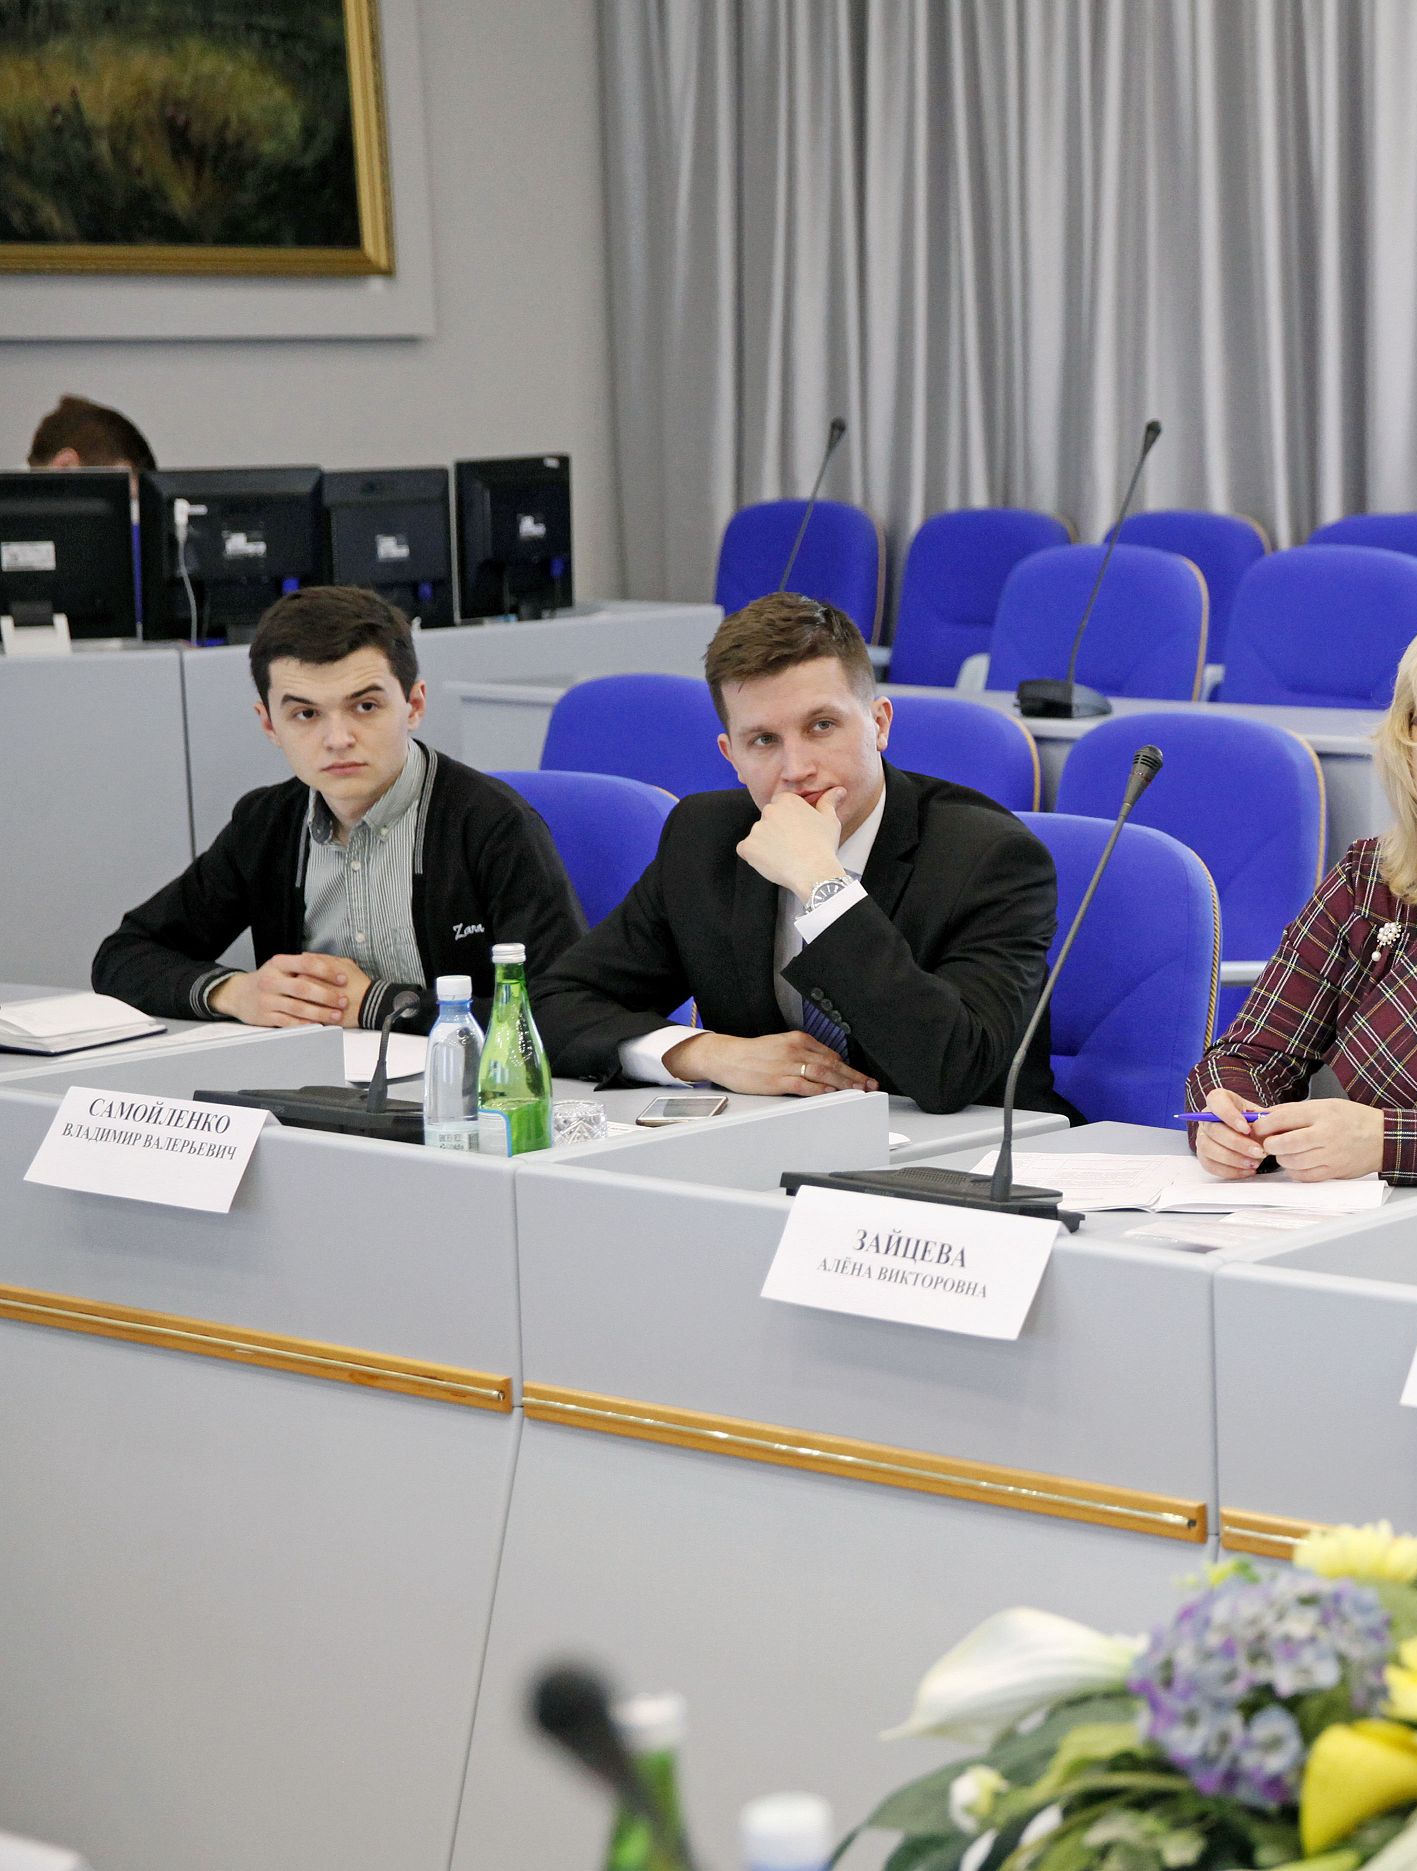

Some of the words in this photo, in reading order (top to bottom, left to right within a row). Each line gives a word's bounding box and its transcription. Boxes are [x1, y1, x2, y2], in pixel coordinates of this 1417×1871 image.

[89, 1098, 231, 1134] САМОЙЛЕНКО
[61, 1123, 142, 1146] ВЛАДИМИР
[143, 1135, 237, 1160] ВАЛЕРЬЕВИЧ
[853, 1228, 967, 1267] ЗАЙЦЕВА
[877, 1266, 987, 1299] ВИКТОРОВНА
